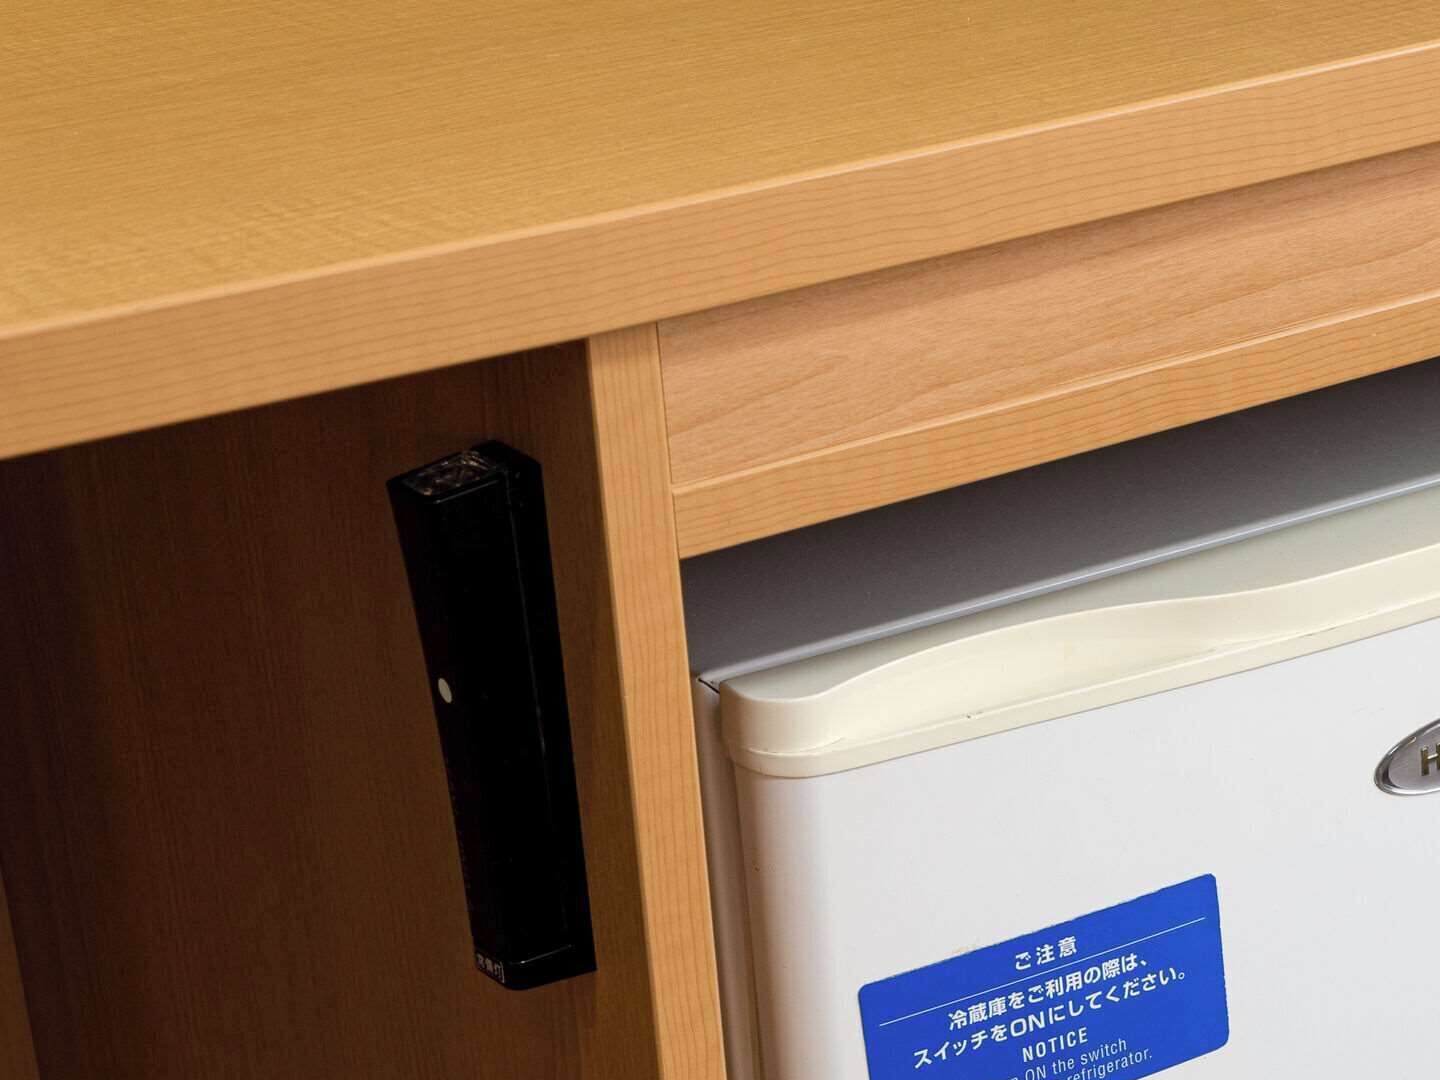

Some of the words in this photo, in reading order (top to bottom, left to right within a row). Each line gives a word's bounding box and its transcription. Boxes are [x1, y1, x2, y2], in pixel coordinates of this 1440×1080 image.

[1015, 936, 1077, 969] ご注意
[948, 953, 1147, 1030] 冷蔵庫をご利用の際は、
[914, 969, 1185, 1068] スイッチをONにしてください。
[1022, 1027, 1088, 1062] NOTICE
[1052, 1058, 1075, 1075] the
[1080, 1039, 1127, 1063] switch
